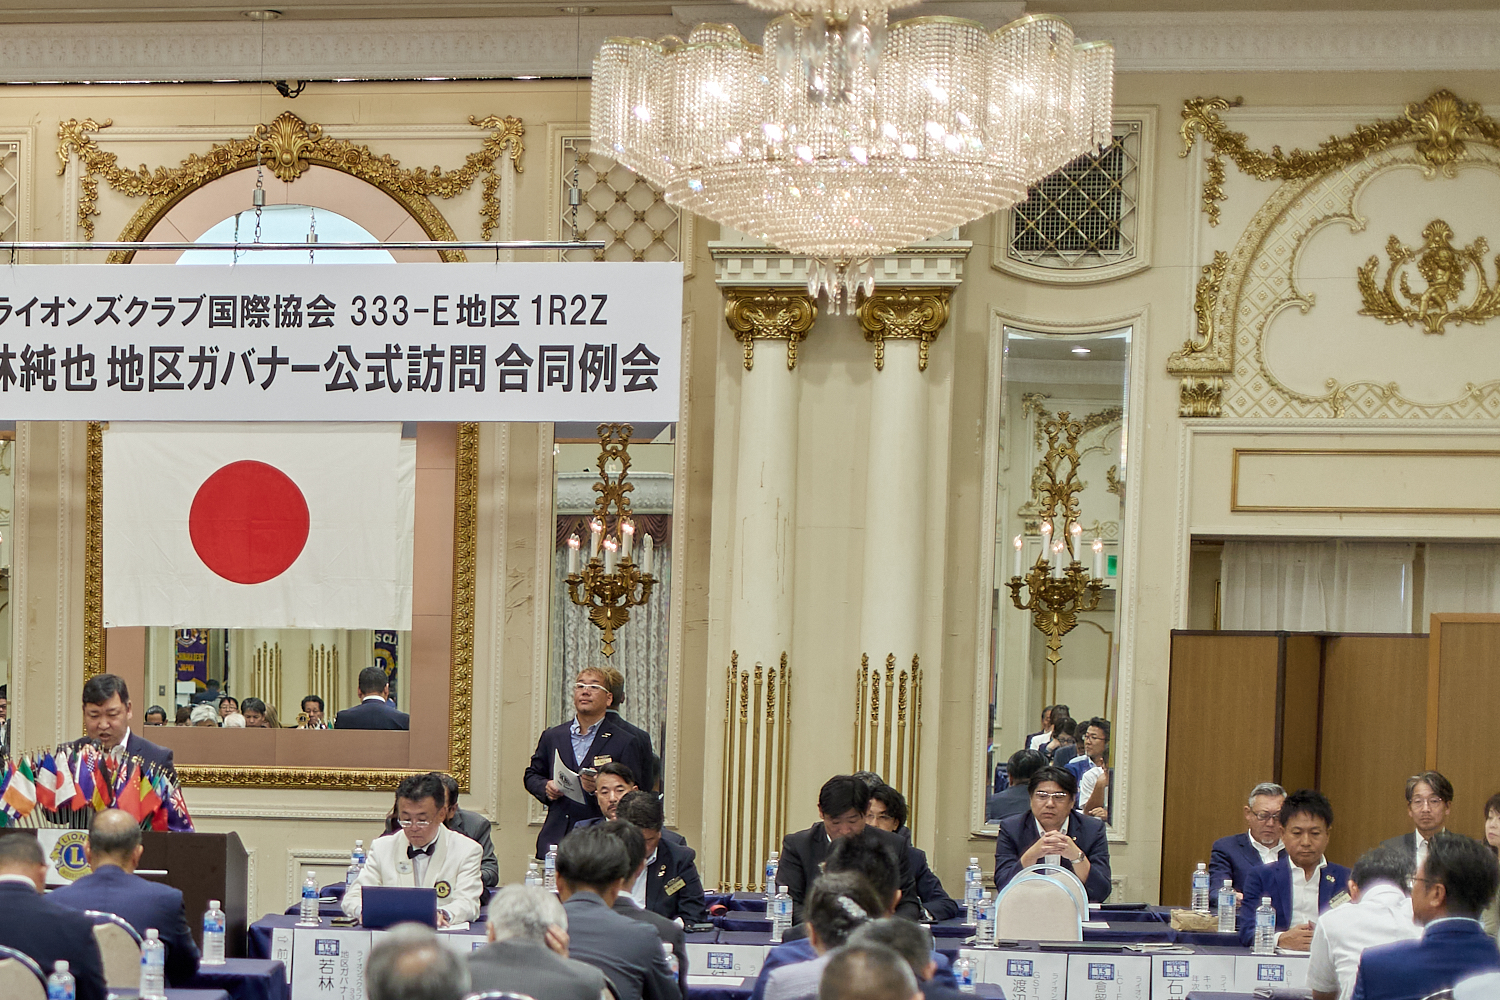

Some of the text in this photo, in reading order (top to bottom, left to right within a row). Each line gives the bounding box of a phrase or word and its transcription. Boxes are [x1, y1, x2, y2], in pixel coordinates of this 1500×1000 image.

[530, 294, 608, 326] 1R2Z
[494, 342, 661, 393] 合同例会
[70, 846, 85, 865] L
